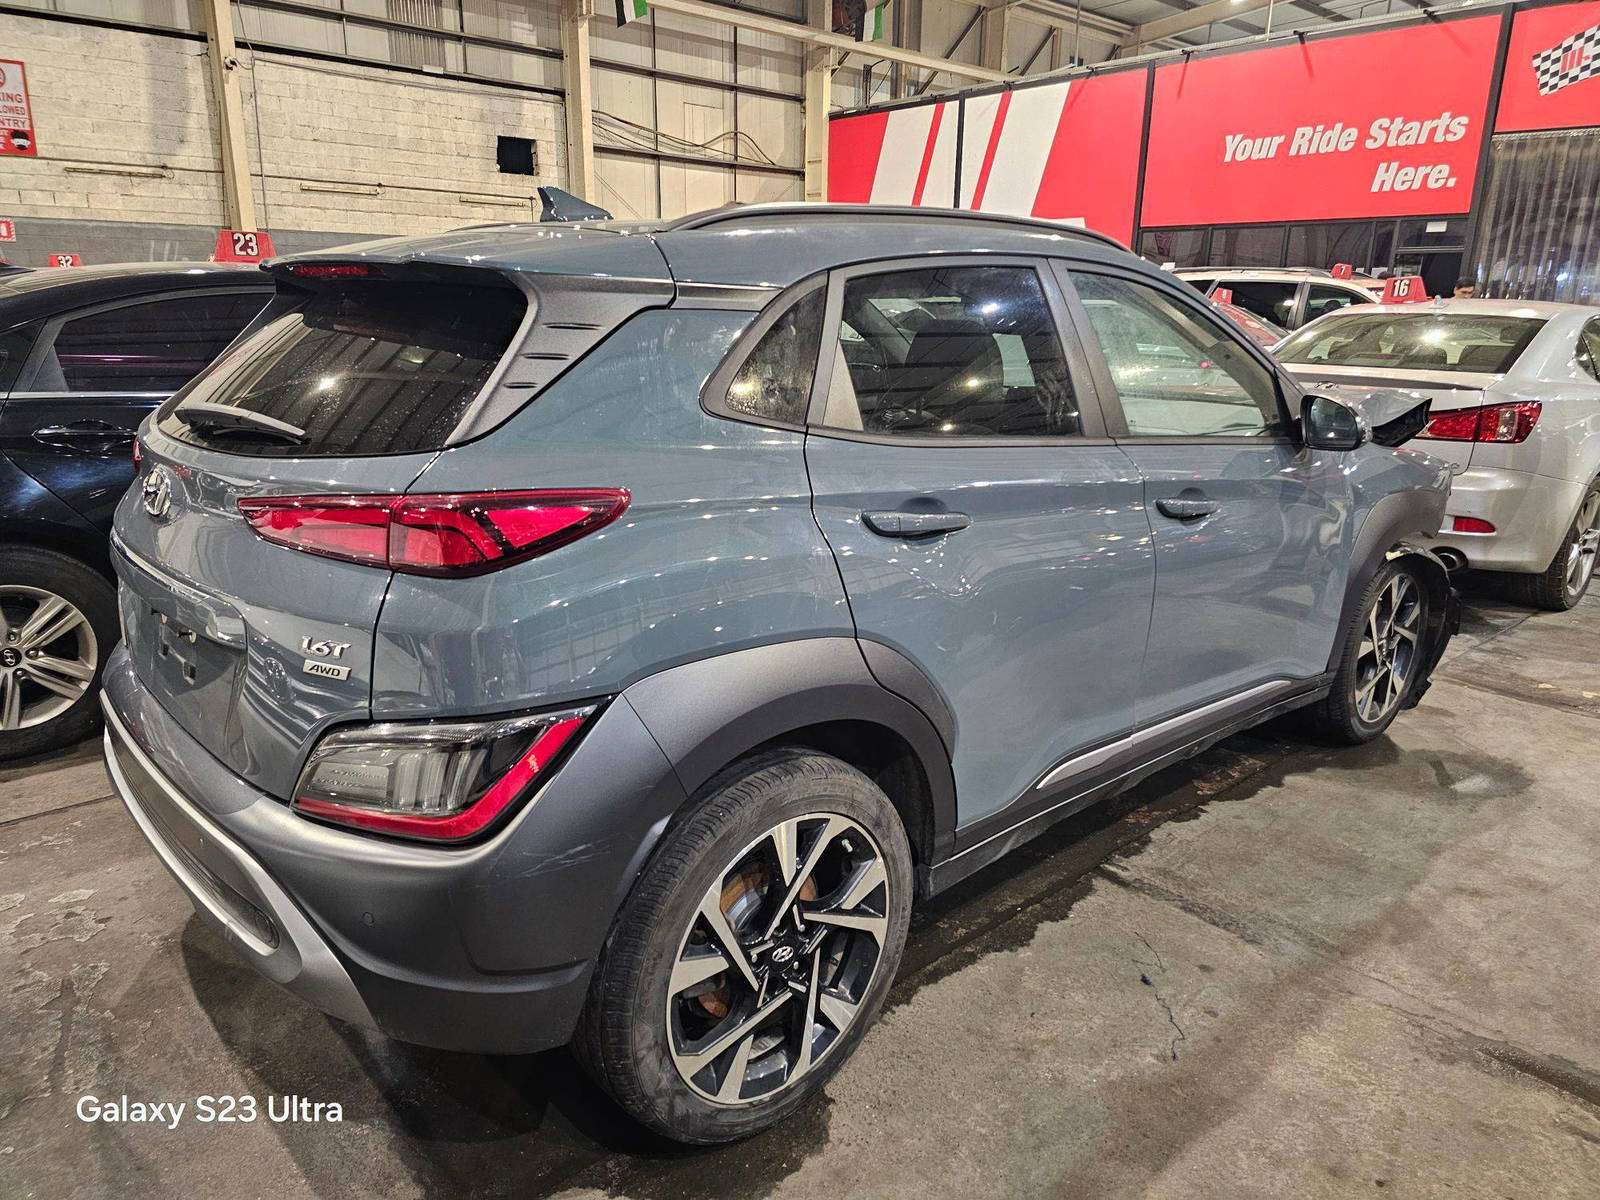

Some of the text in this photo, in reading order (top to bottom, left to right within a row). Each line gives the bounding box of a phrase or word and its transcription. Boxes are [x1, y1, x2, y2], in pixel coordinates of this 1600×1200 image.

[1223, 111, 1469, 163] Your Ride Starts
[1370, 161, 1457, 193] Here.
[233, 232, 259, 256] 23
[57, 255, 73, 267] 32
[1393, 279, 1410, 297] 16
[308, 664, 341, 677] AWD
